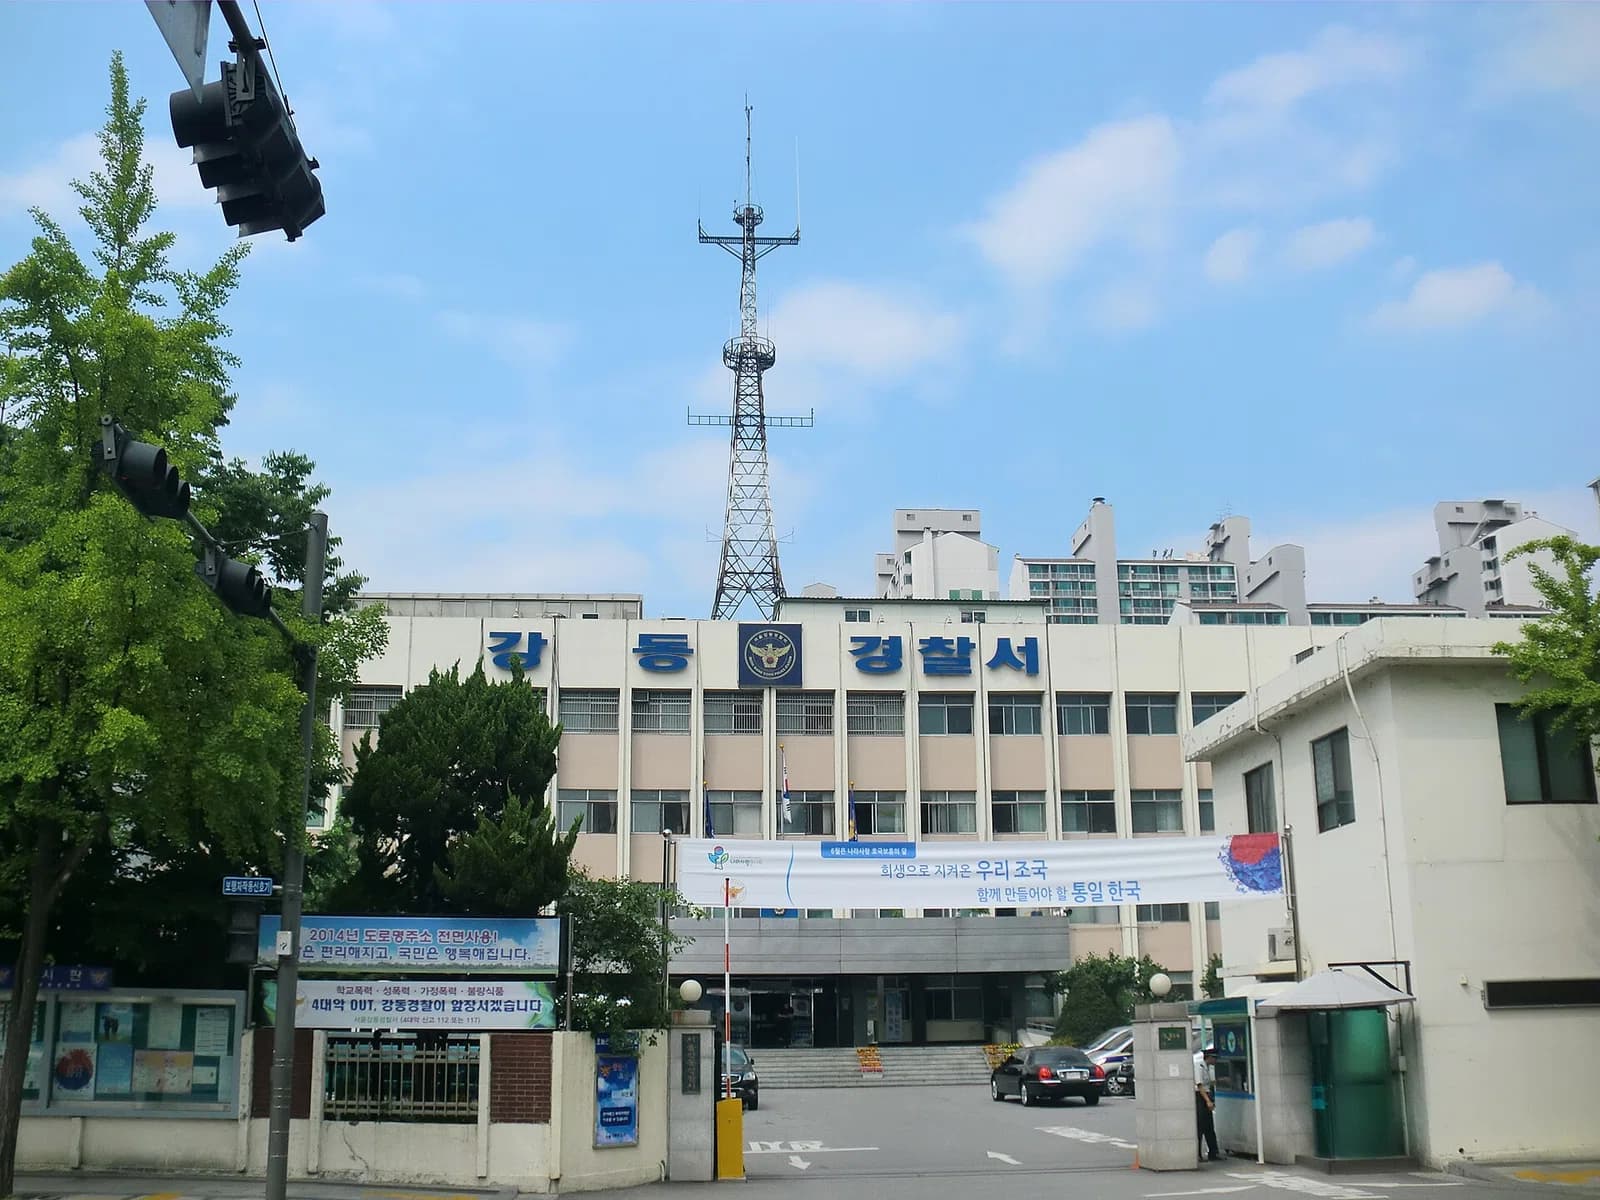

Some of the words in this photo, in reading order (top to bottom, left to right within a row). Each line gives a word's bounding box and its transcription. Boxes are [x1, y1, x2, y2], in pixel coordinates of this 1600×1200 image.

[848, 635, 1040, 675] 경찰서
[880, 863, 931, 879] 희생으로
[934, 863, 972, 879] 지켜온
[976, 859, 1009, 881] 우리
[1014, 859, 1049, 881] 조국
[976, 886, 1001, 903] 함께
[1005, 886, 1053, 903] 만들어야
[1056, 886, 1067, 902] 할
[1071, 881, 1104, 903] 통일
[1107, 880, 1142, 902] 한국
[309, 928, 358, 943] 2014년
[364, 929, 432, 943] 도로명주소
[438, 929, 499, 944] 전면사용!
[321, 946, 393, 960] 편리해지고,
[399, 946, 439, 960] 국민은
[445, 946, 532, 961] 행복해집니다.
[337, 986, 373, 996] 학교폭력
[383, 986, 410, 996] 성폭력
[420, 987, 457, 996] 가정폭력
[311, 998, 345, 1012] 4대악
[382, 999, 445, 1012] 강동경찰이
[451, 999, 543, 1013] 앞장서겠습니다
